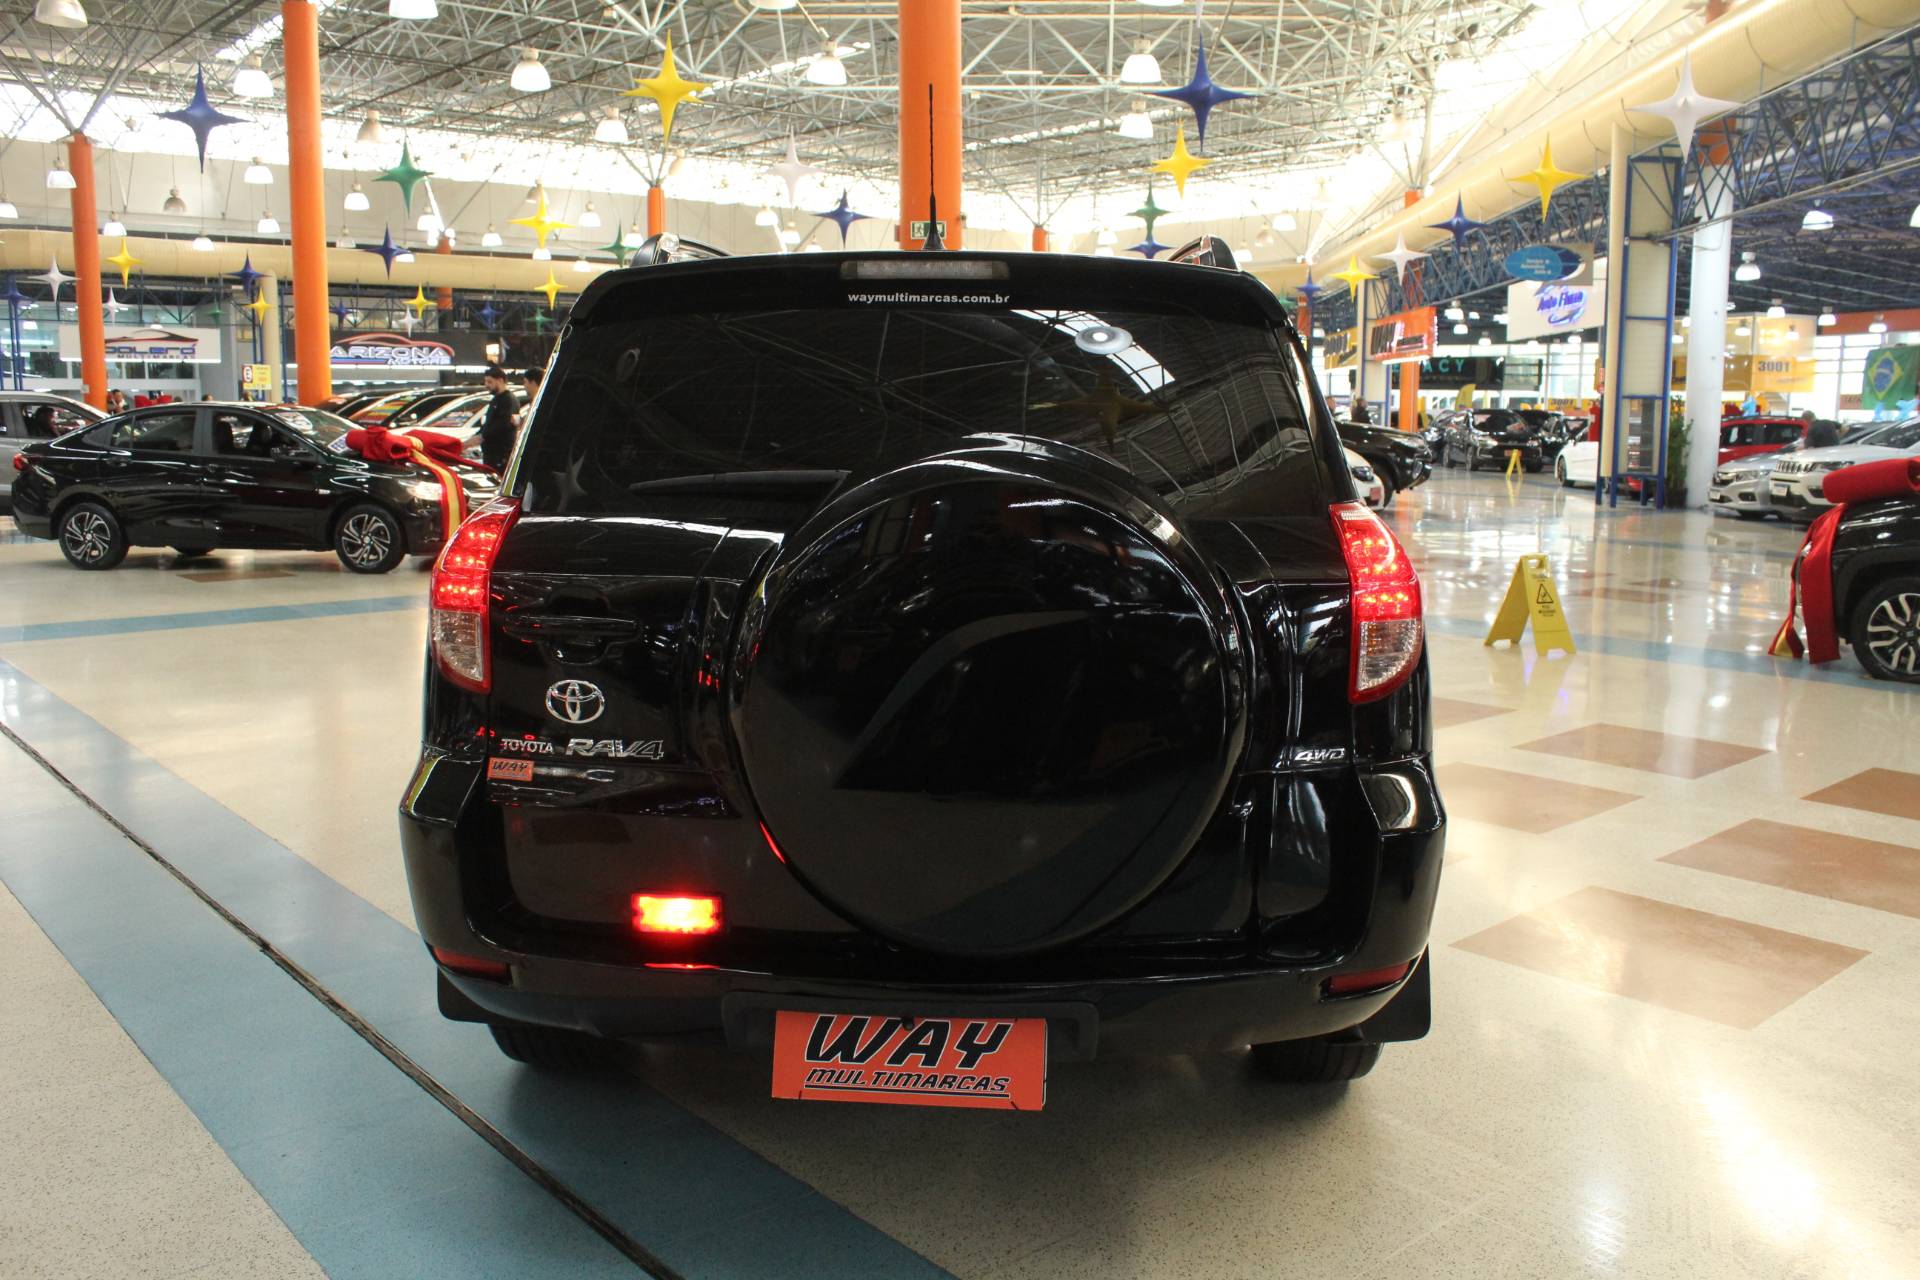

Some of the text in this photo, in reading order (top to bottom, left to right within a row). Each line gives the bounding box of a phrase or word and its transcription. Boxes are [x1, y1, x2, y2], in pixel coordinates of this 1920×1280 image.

[848, 292, 1010, 304] waymultimarcas.com.br
[330, 346, 451, 359] ARIZONA
[1758, 360, 1790, 372] 3001
[501, 738, 665, 760] TOYOTA RAV4
[1294, 747, 1345, 761] 4WD
[493, 761, 528, 772] WAY
[804, 1014, 1014, 1070] WAY
[805, 1067, 1012, 1093] MULTIMARCAS
